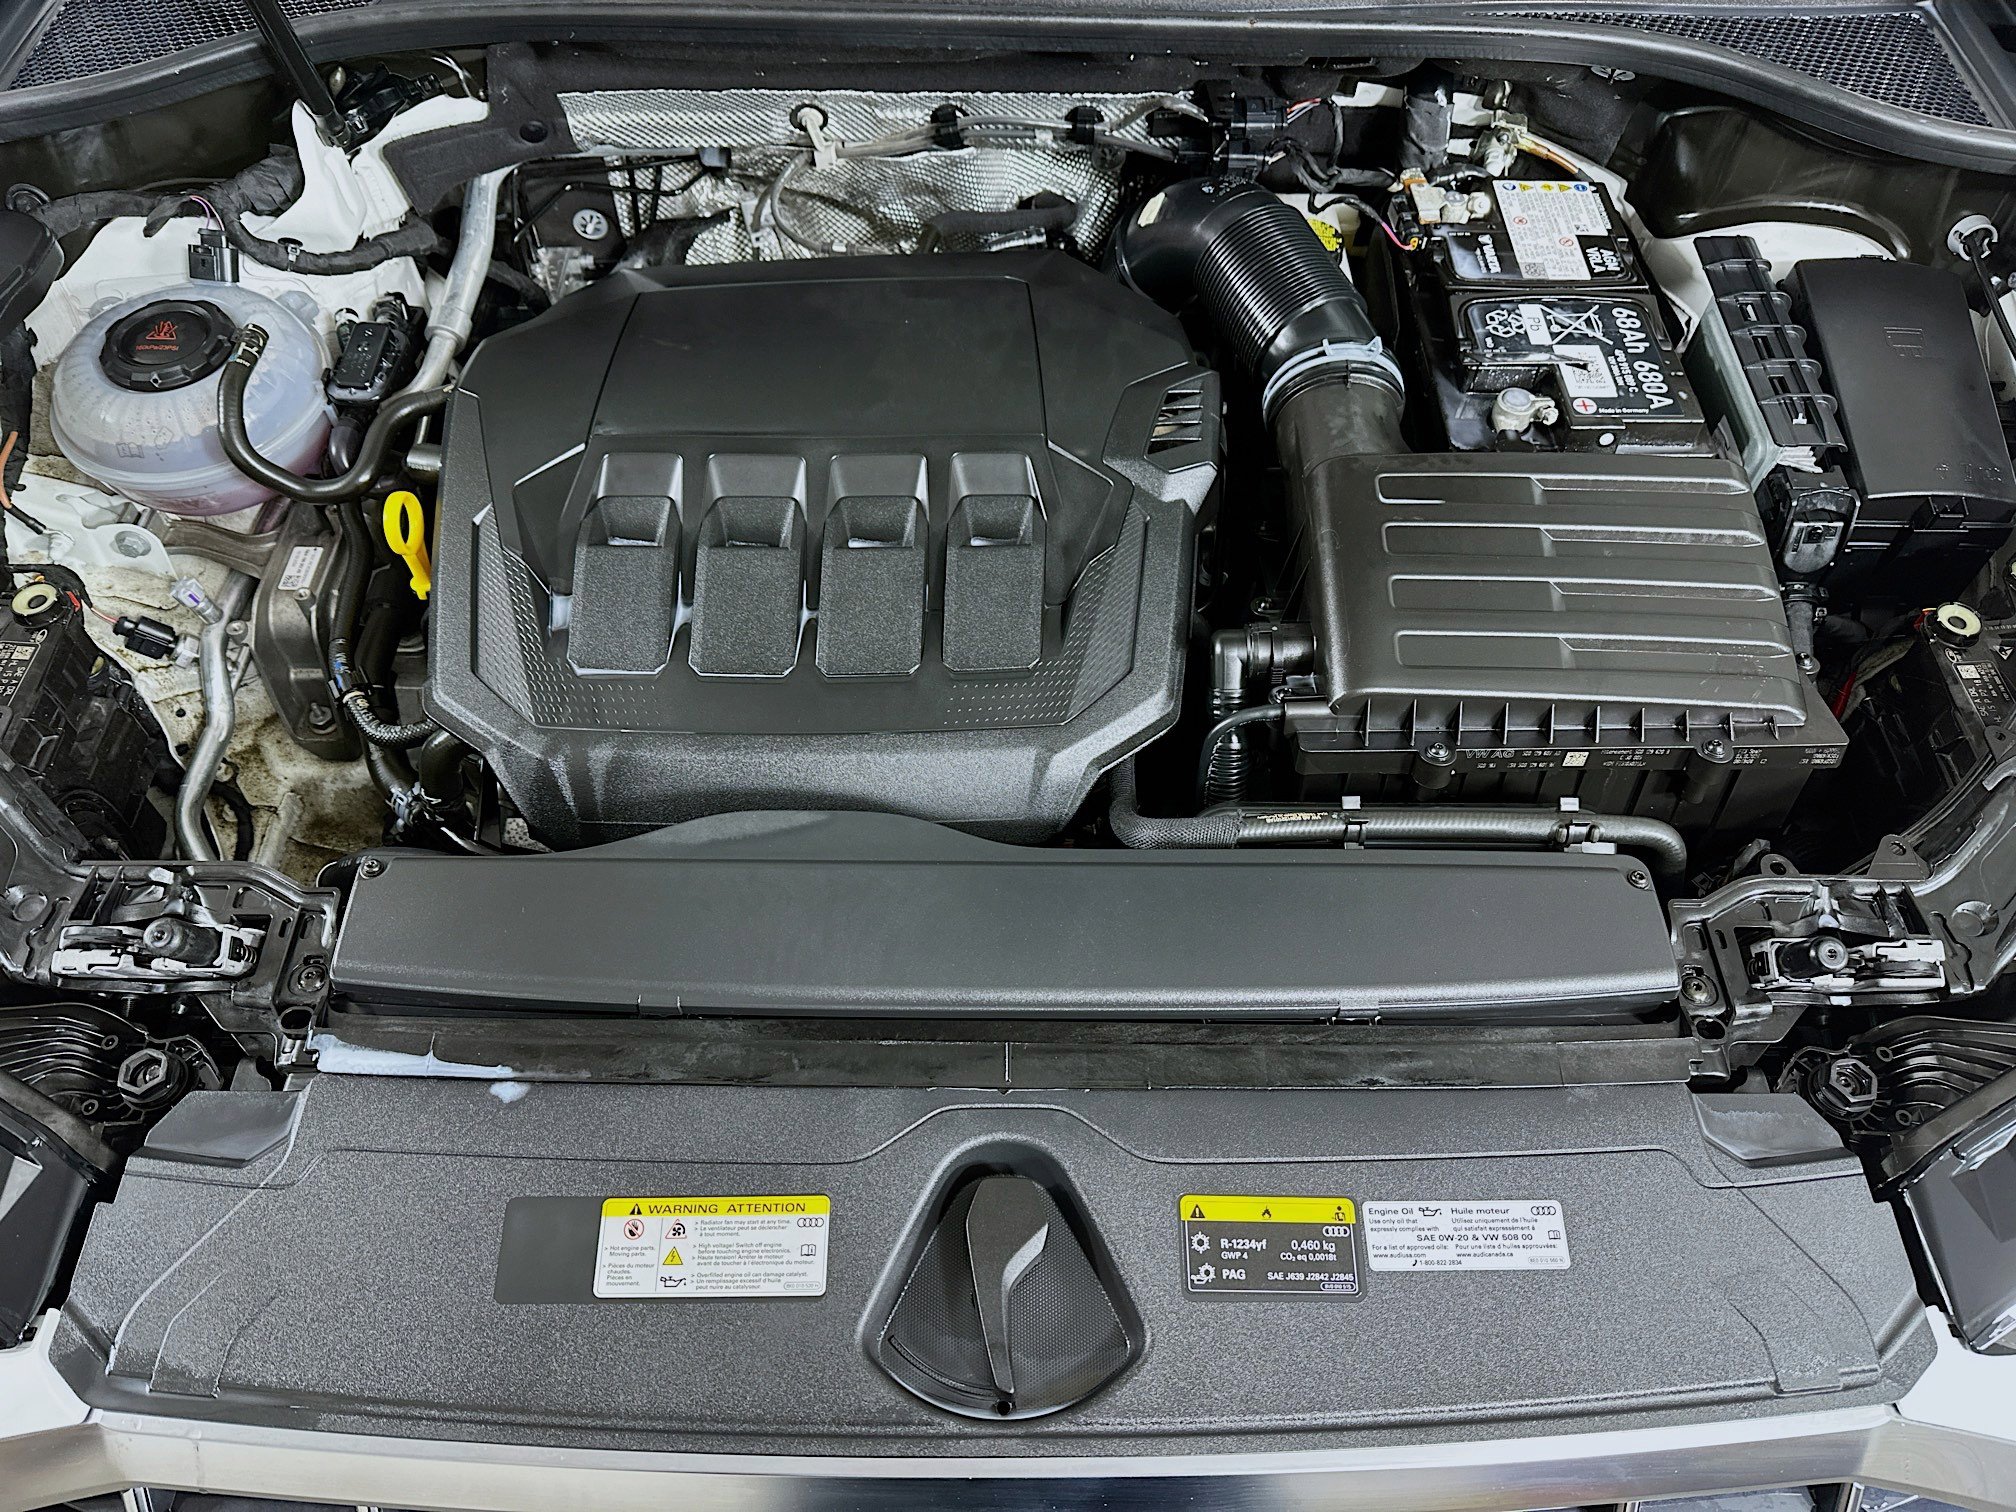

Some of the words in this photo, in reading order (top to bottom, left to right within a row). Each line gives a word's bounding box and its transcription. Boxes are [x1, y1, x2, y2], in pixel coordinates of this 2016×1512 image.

[1586, 247, 1606, 272] VRLA
[1527, 316, 1540, 332] Pb
[1611, 307, 1650, 354] 68Ah
[1633, 360, 1674, 410] 680A
[1466, 750, 1490, 758] VW
[1491, 750, 1515, 758] AG
[648, 1204, 718, 1214] WARNING
[726, 1203, 806, 1213] ATTENTION
[1368, 1208, 1398, 1216] Engine
[1220, 1238, 1267, 1251] R-1234yf
[1291, 1240, 1321, 1251] 0,460
[1322, 1240, 1335, 1252] kg
[1221, 1251, 1241, 1259] GWP
[1222, 1269, 1246, 1280] PAG
[1267, 1272, 1284, 1280] SAE
[1286, 1272, 1304, 1280] J639
